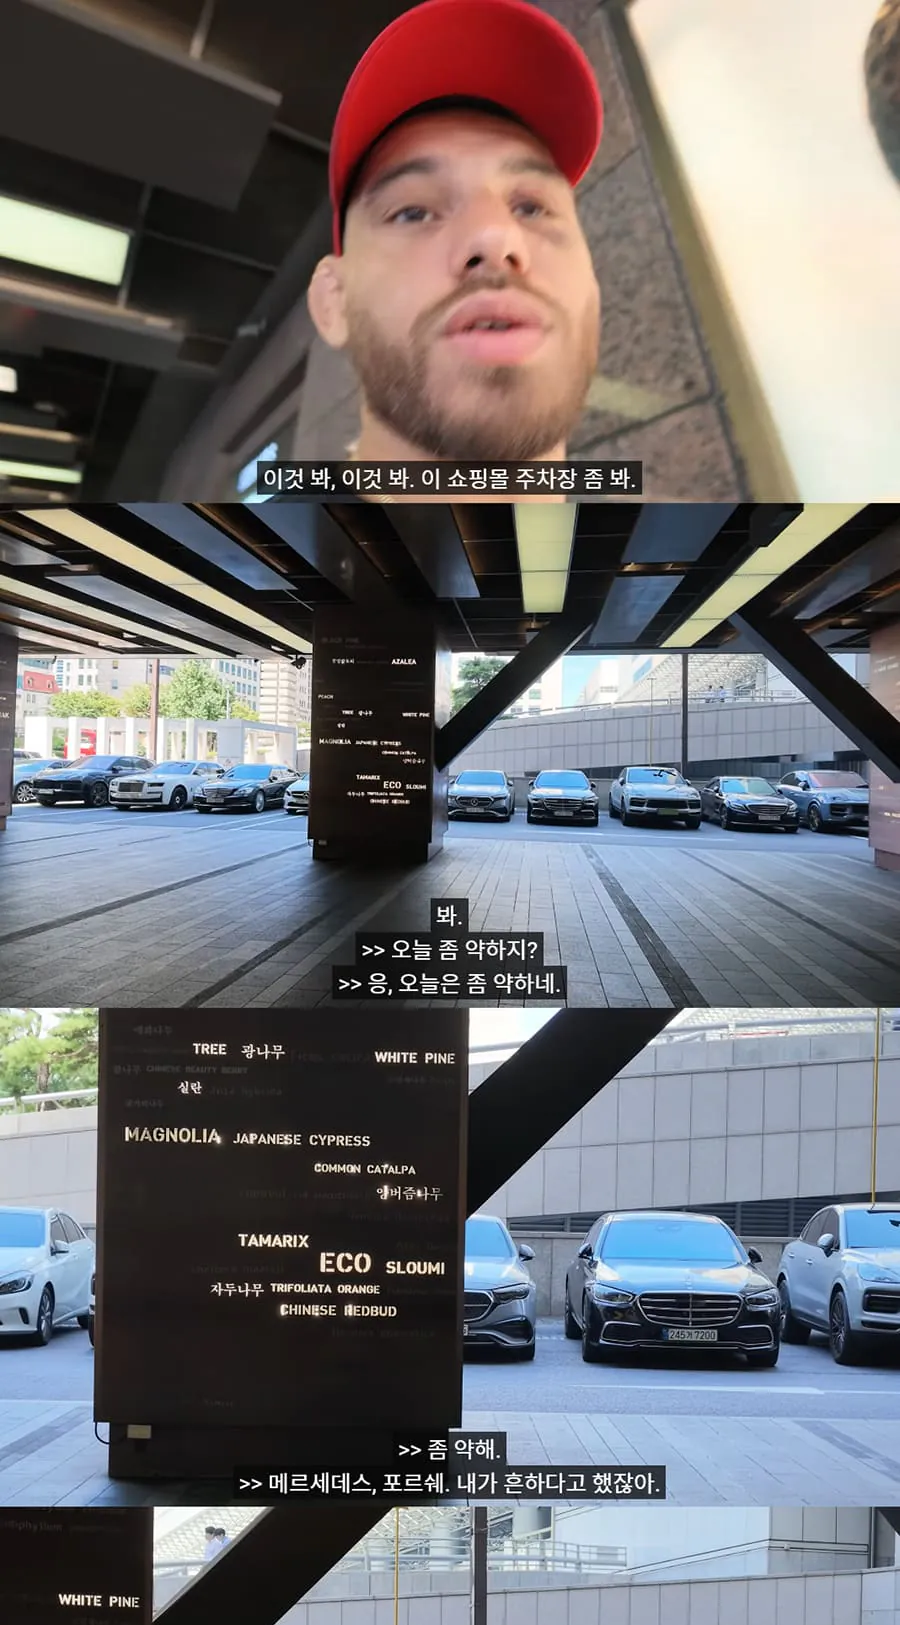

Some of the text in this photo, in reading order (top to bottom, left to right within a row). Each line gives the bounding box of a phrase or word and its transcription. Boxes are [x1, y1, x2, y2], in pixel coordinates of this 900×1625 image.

[384, 781, 402, 790] ECO
[192, 1042, 227, 1056] TREE
[240, 1043, 286, 1061] 광나무
[374, 1051, 418, 1064] WHITE
[424, 1052, 456, 1065] PINE
[177, 1080, 203, 1095] 실란
[124, 1126, 222, 1145] MAGNOLIA
[232, 1132, 371, 1147] JAPANESE CYPRESS
[313, 1162, 416, 1175] COMMON CATALPA
[237, 1233, 310, 1249] TAMARIX
[319, 1251, 445, 1275] ECO SLOUMI
[210, 1282, 265, 1298] 자두나무
[269, 1282, 381, 1295] TRIFOLIATA ORANGE
[279, 1303, 397, 1317] CHINESE REDBUD
[58, 1593, 140, 1608] WHITE PINE
